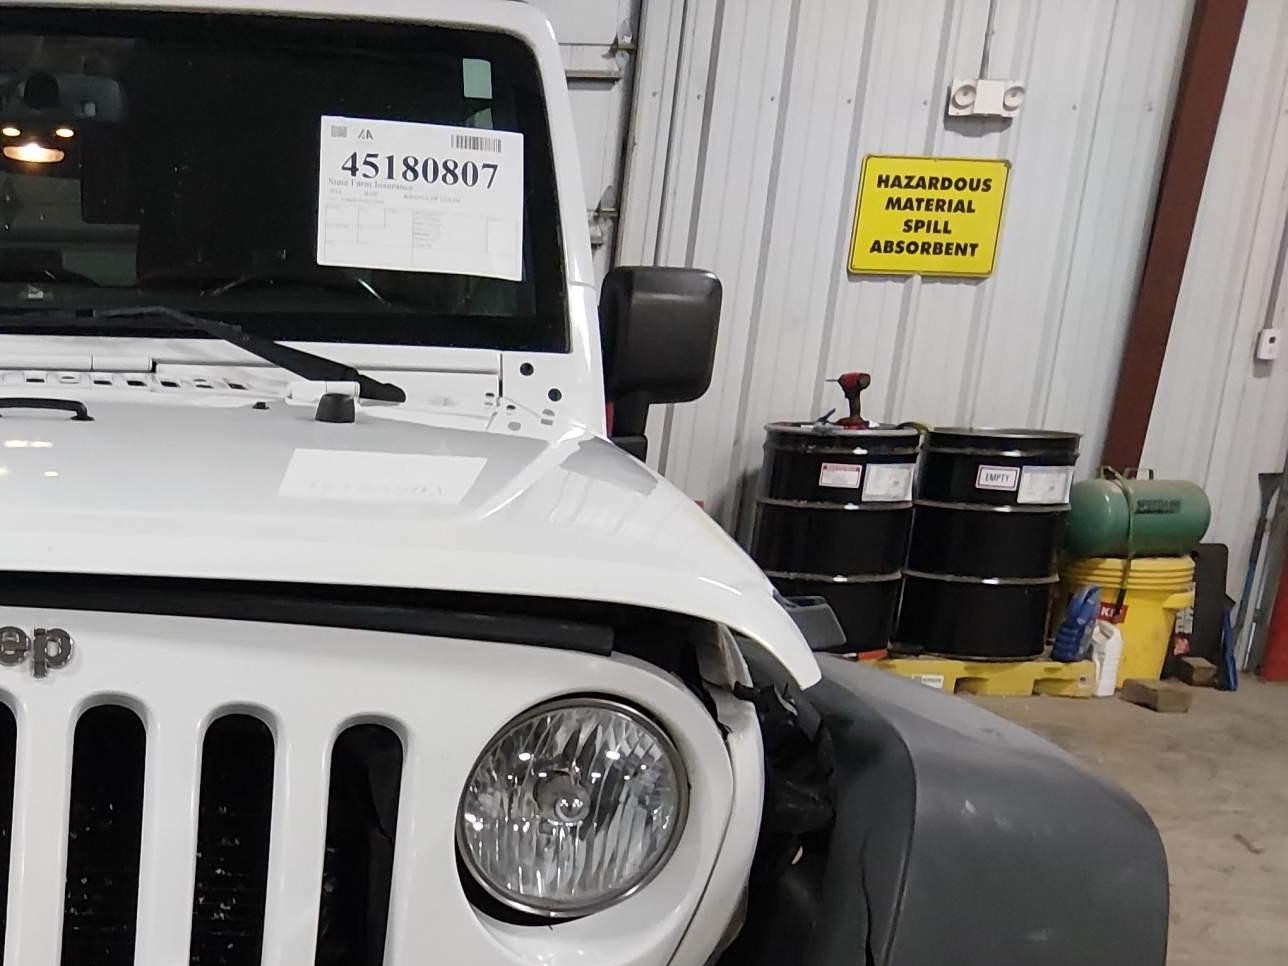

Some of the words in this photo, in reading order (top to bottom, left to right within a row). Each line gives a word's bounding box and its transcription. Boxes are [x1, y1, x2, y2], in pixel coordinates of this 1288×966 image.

[342, 152, 497, 188] 45180807
[877, 175, 992, 192] HAZARDOUS
[886, 197, 975, 213] MATERIAL
[903, 220, 951, 234] SPILL
[870, 240, 978, 256] ABSORBENT
